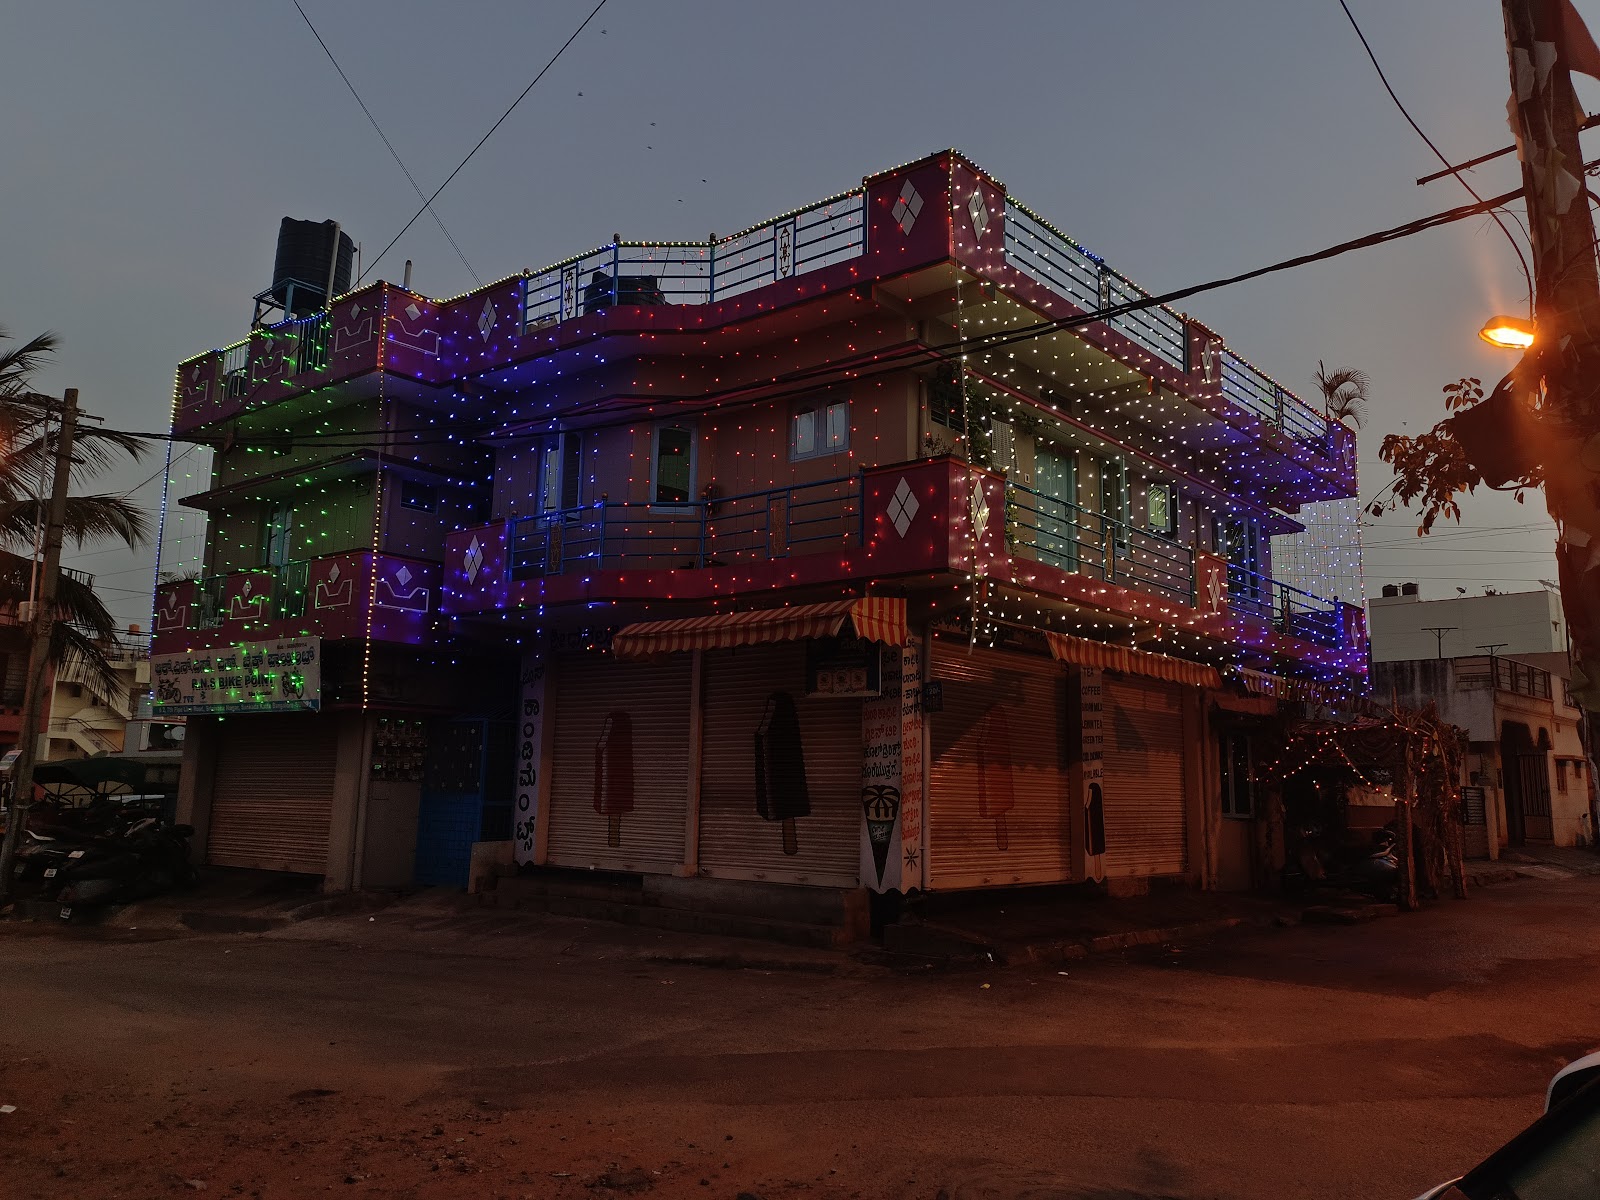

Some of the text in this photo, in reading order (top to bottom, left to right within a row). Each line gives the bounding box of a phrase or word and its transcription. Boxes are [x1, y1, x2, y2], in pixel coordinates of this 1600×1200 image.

[1082, 667, 1094, 677] TEA
[191, 674, 273, 690] R.N.S BIKE POINT
[1081, 686, 1101, 696] COFFEE
[1094, 719, 1103, 729] TEA
[1095, 735, 1103, 744] TEA
